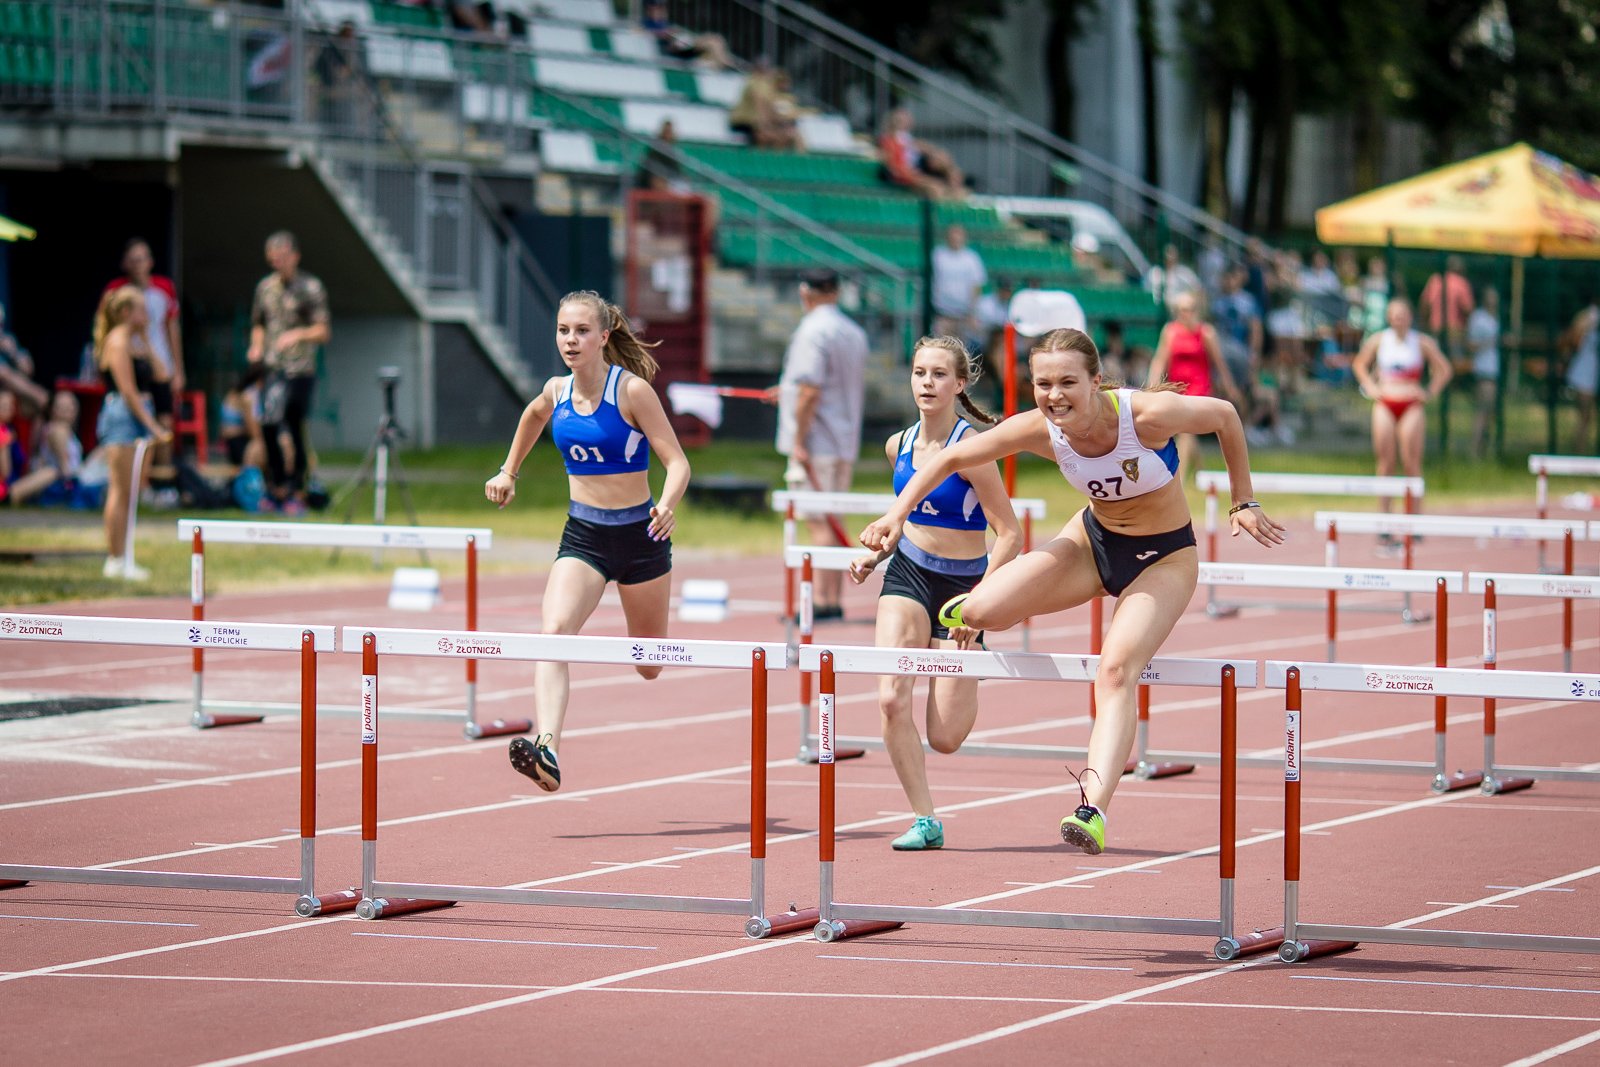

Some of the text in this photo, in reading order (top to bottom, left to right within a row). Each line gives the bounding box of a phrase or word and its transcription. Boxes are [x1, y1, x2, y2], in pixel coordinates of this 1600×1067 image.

[569, 444, 605, 463] 01
[1087, 476, 1123, 499] 87
[34, 619, 63, 627] Sportowy
[18, 626, 63, 636] ZŁOTNICZA
[213, 627, 241, 636] TERMY
[204, 636, 248, 645] CIEPLICKIE
[471, 638, 501, 646] Sportowy
[456, 645, 502, 654] ZŁOTNICZA
[657, 645, 685, 653] TERMY
[648, 653, 693, 662] CIEPLICKIE
[916, 664, 963, 673] ZŁOTNICZA
[1402, 674, 1434, 682] Sportowy
[1385, 681, 1434, 691] ZŁOTNICZA
[363, 693, 374, 732] polanik
[821, 712, 831, 751] polanik
[1286, 728, 1297, 769] polanik
